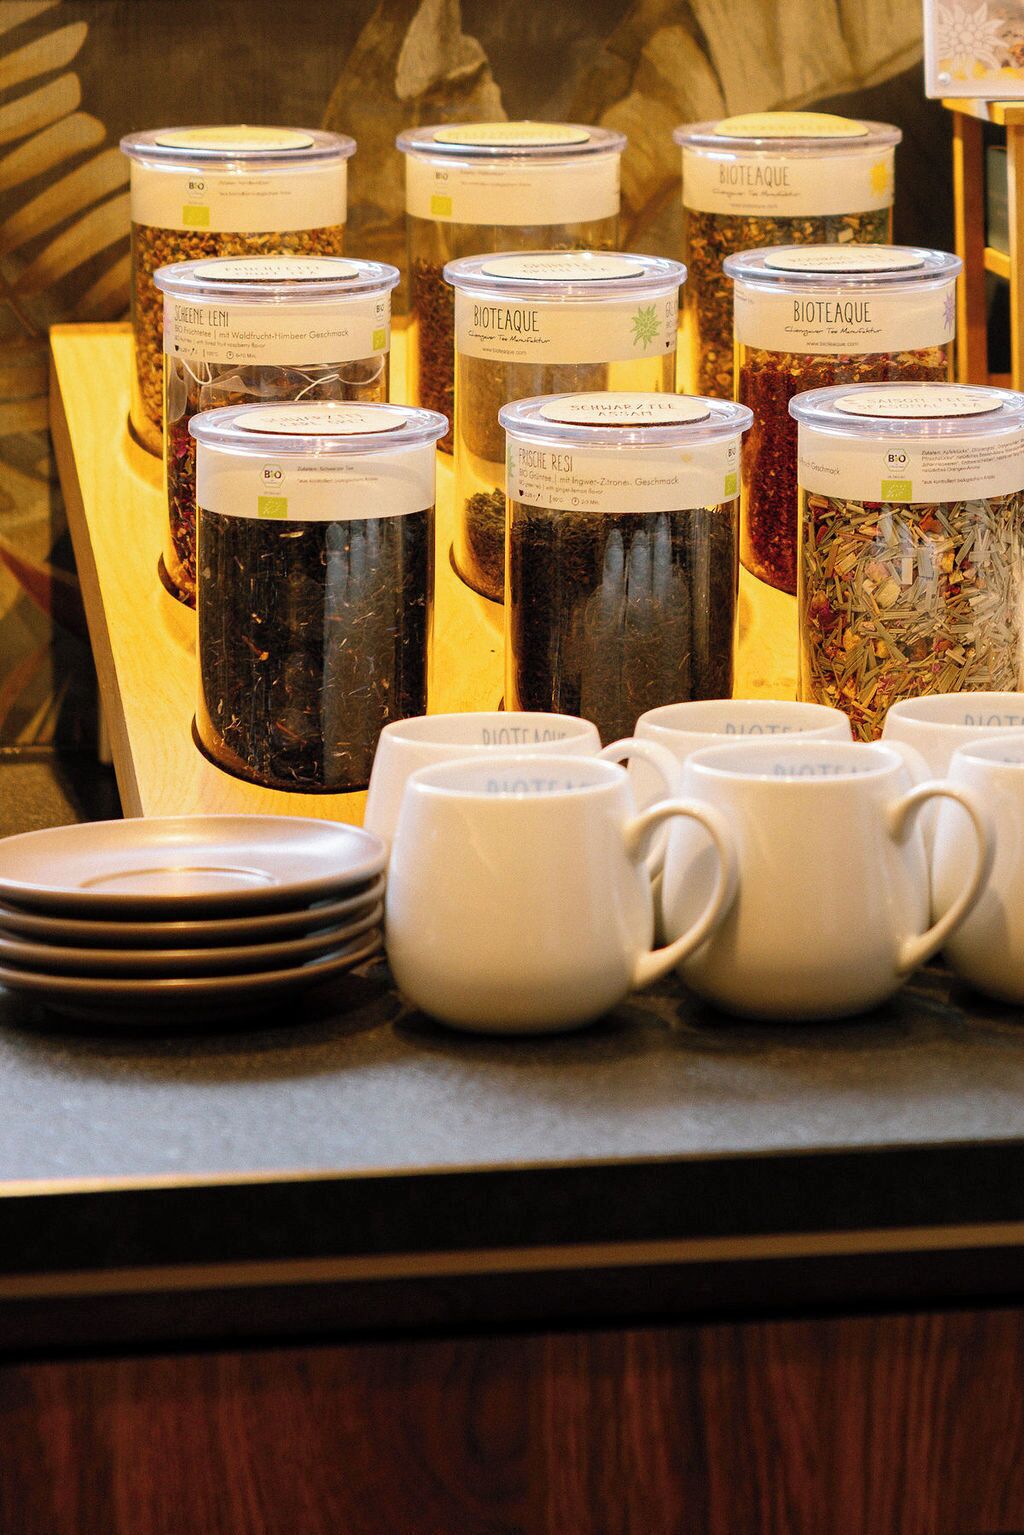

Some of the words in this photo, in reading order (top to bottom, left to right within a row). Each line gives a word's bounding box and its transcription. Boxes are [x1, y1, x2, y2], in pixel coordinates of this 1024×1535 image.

[719, 164, 791, 187] BIOTEAQUE
[174, 304, 204, 326] SCHEENE
[208, 309, 229, 328] LENI
[473, 303, 540, 333] BIOTEAQUE
[793, 299, 872, 325] BIOTEAQUE
[231, 330, 307, 341] Waldfrucht-Himbeer
[309, 328, 350, 340] Geschmack
[826, 325, 839, 335] Tee
[498, 332, 508, 342] Tee
[518, 447, 547, 470] FRISCHE
[551, 453, 573, 473] RESI
[887, 453, 907, 463] BIO
[264, 469, 282, 480] BIO
[559, 476, 571, 485] mit
[634, 475, 679, 487] Geschmack
